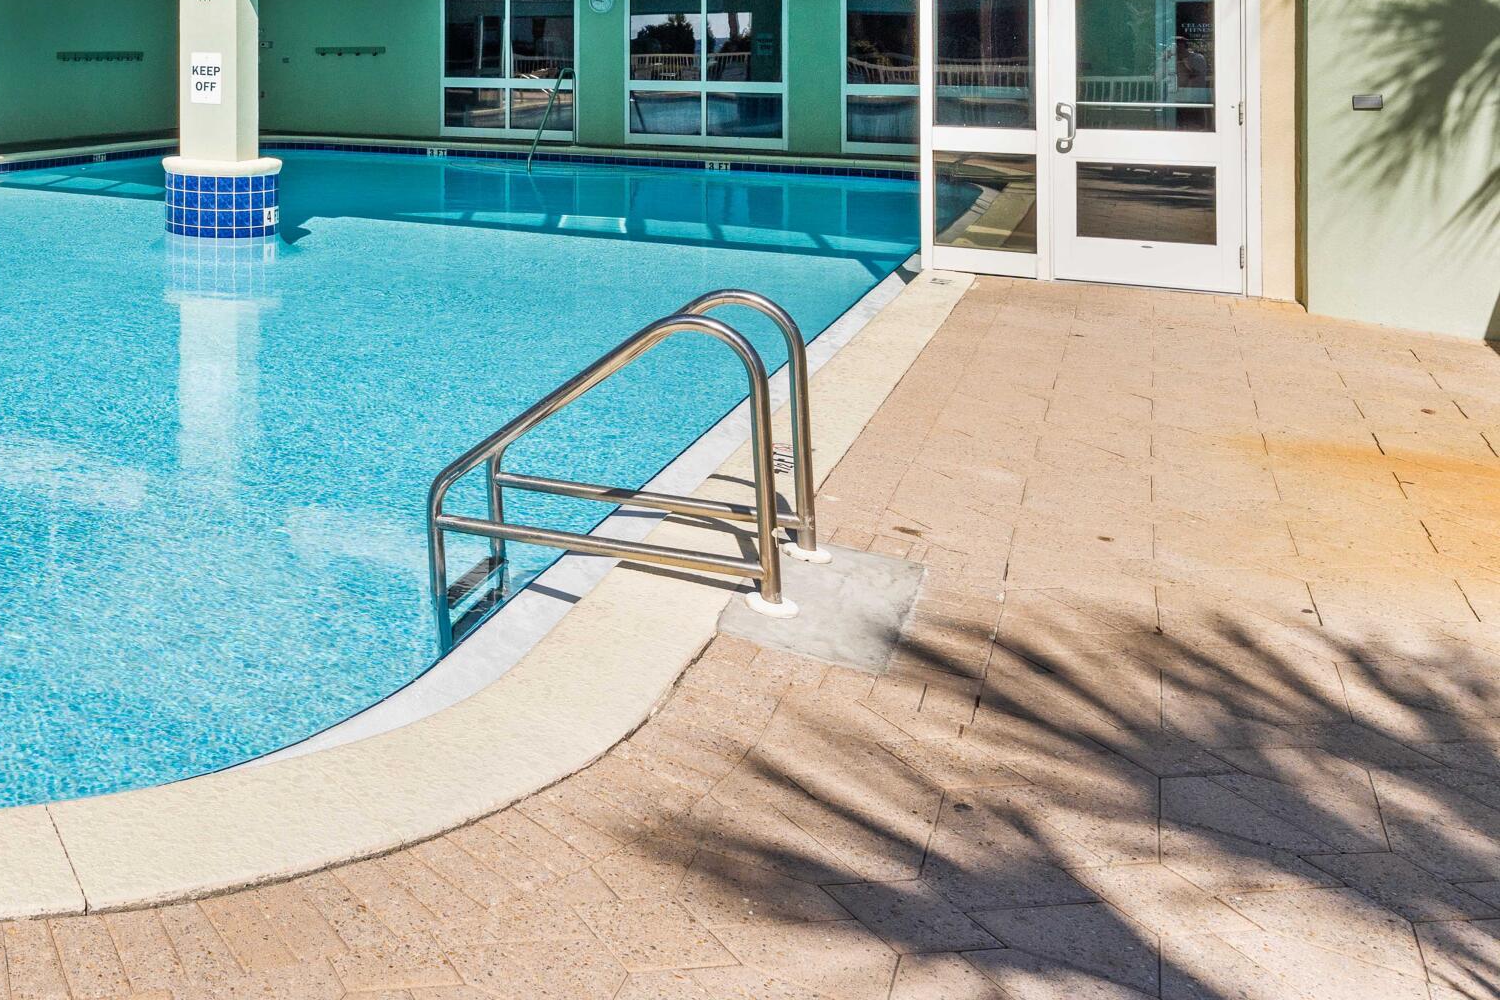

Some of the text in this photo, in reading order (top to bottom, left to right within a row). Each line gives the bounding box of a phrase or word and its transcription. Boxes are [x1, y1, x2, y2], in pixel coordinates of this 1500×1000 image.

[192, 65, 221, 76] KEEP
[195, 81, 217, 92] OFF
[718, 162, 729, 170] FT
[266, 210, 272, 223] 4
